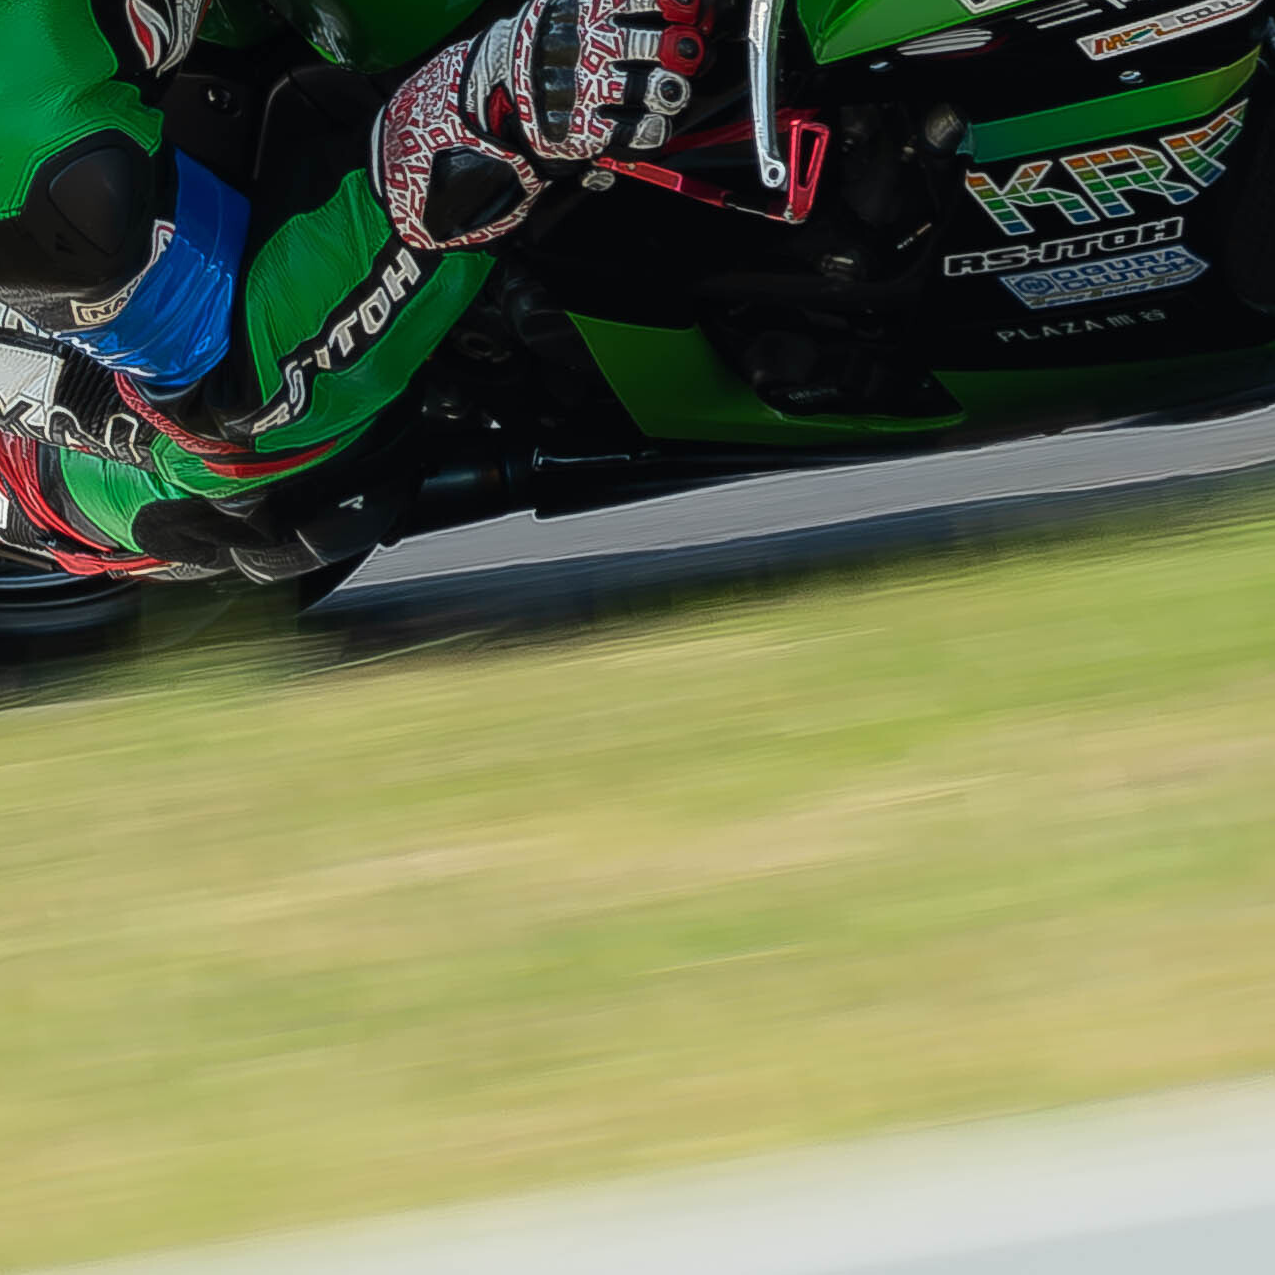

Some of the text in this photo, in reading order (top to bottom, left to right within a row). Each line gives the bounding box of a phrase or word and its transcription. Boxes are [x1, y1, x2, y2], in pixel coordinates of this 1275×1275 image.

[943, 215, 1185, 277] RS-ITOH
[1051, 248, 1188, 281] OGURA
[1062, 257, 1196, 293] CLUTCH
[996, 319, 1105, 343] PLAZA
